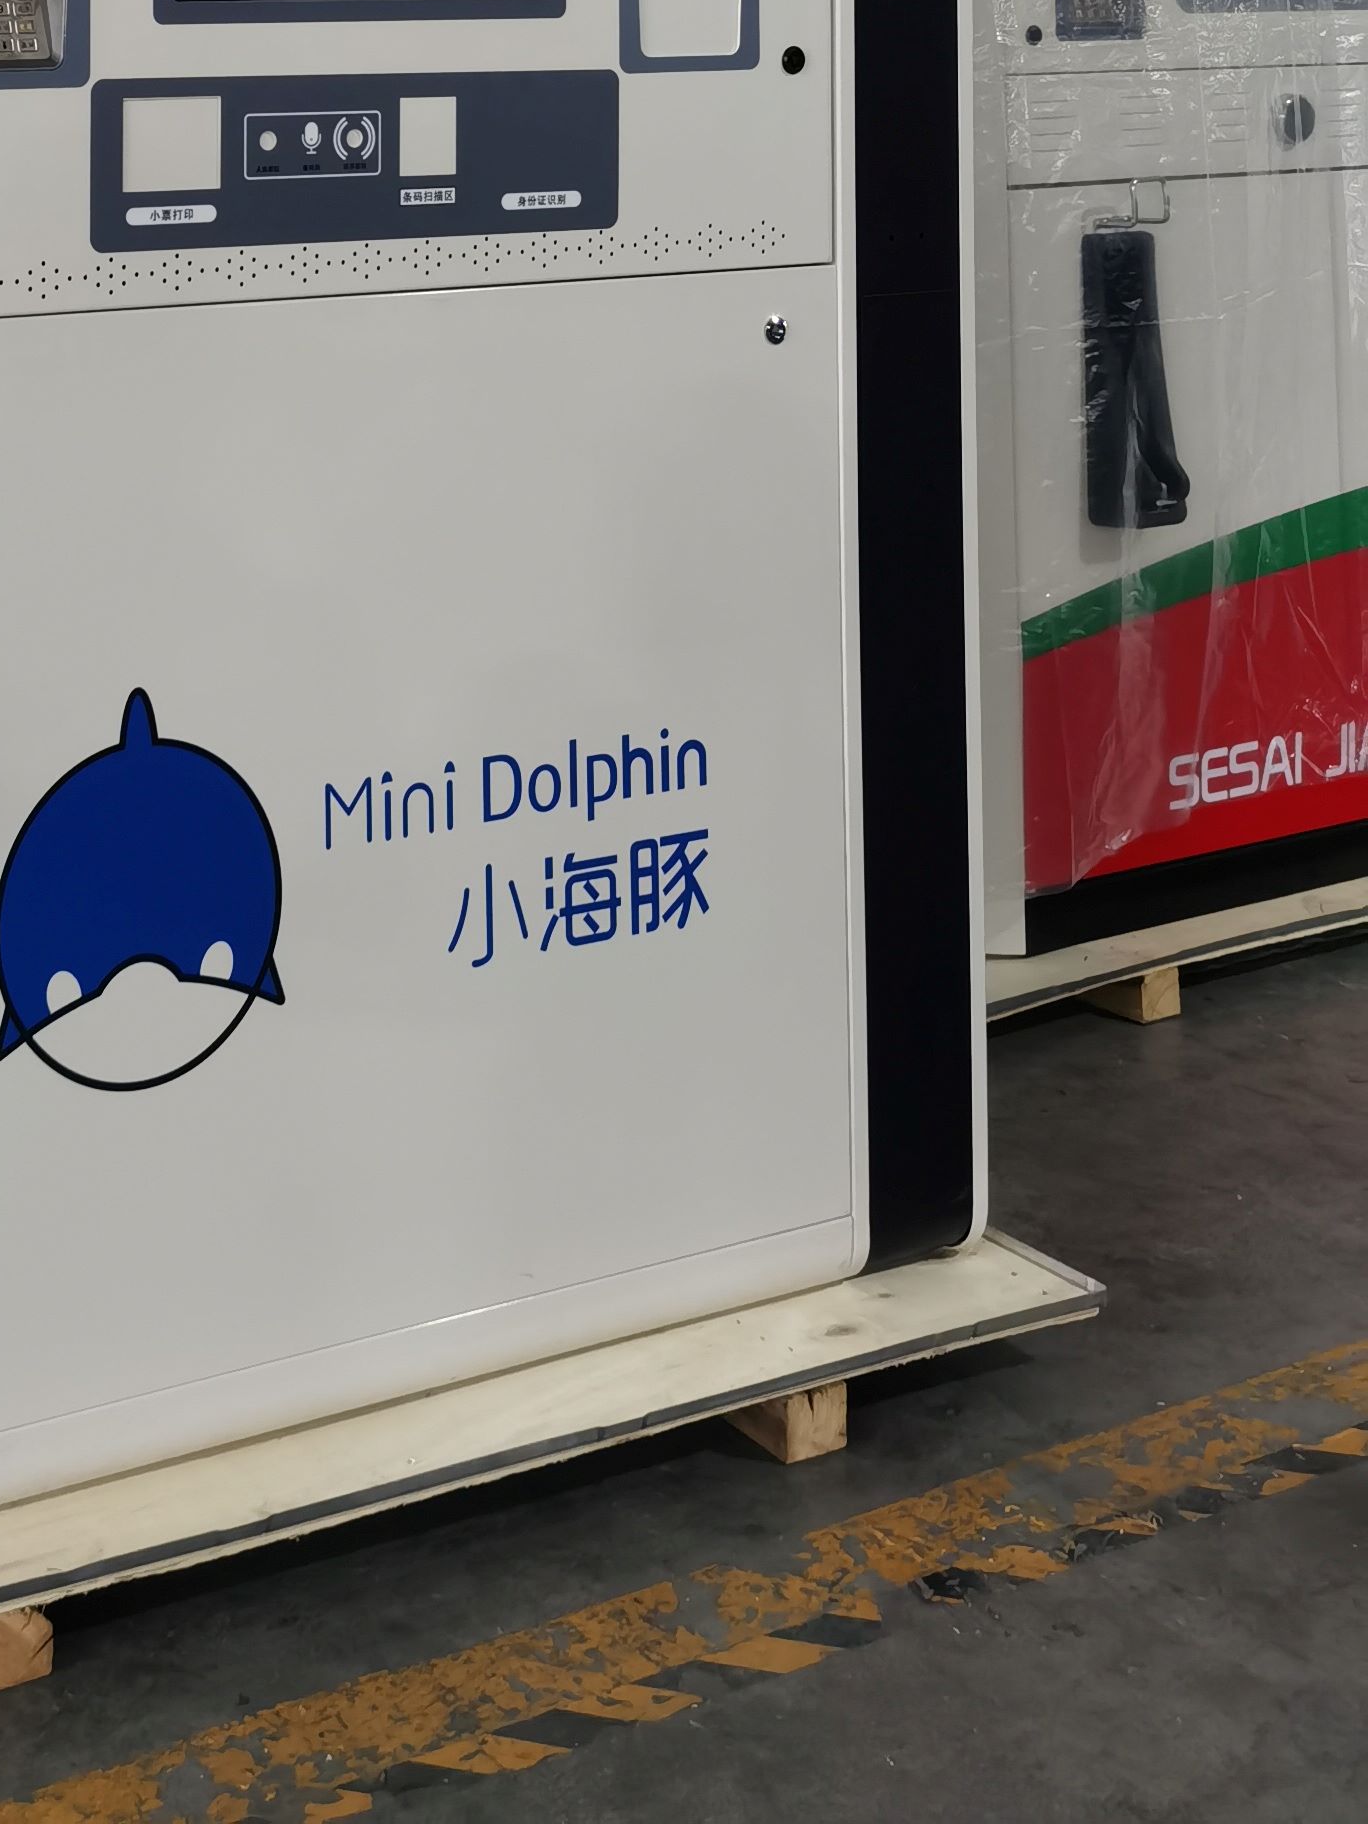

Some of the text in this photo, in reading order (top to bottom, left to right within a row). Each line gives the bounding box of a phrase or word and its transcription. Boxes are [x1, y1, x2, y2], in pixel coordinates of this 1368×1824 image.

[149, 208, 194, 222] 小票打印
[402, 189, 454, 203] 条码扫描区
[517, 194, 567, 207] 身份证识别
[325, 728, 708, 850] Mini Dolphin
[1168, 731, 1303, 810] SESAI
[447, 828, 710, 968] 小海豚
